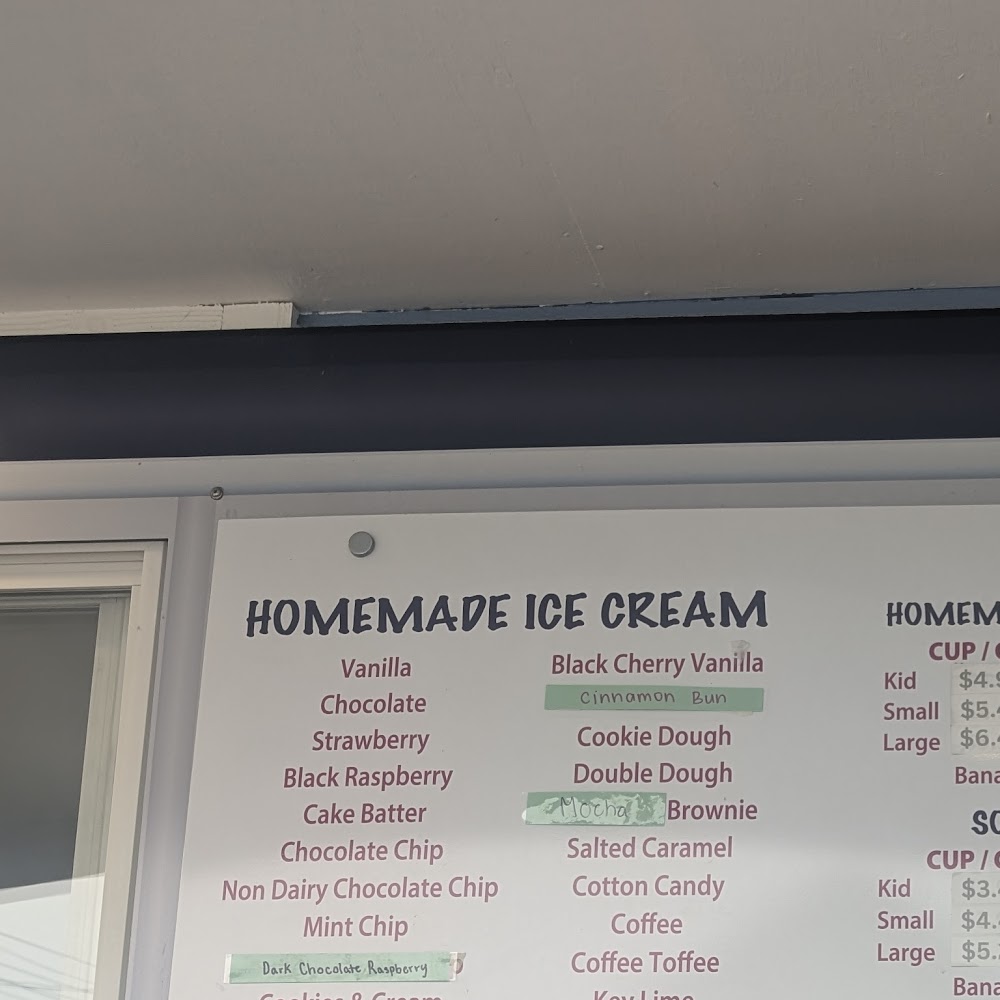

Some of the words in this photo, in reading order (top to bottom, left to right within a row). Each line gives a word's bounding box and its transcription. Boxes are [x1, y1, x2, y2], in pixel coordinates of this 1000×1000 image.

[246, 594, 510, 637] HOMEMADE
[525, 593, 587, 629] ICE
[601, 590, 768, 629] CREAM
[929, 642, 975, 660] CUP
[342, 657, 411, 678] Vanilla
[552, 653, 608, 674] Black
[614, 653, 685, 678] Cherry
[691, 652, 763, 672] Vanilla
[885, 672, 916, 689] Kid
[692, 691, 726, 704] Bun
[884, 702, 938, 720] Small
[312, 729, 429, 754] Strawberry
[578, 725, 651, 746] Cookie
[659, 725, 731, 751] Dough
[884, 734, 940, 755] Large
[284, 766, 339, 788] Black
[345, 765, 453, 791] Raspberry
[668, 799, 757, 820] Brownie
[281, 840, 387, 862] Chocolate
[394, 839, 443, 865] Chip
[879, 879, 910, 897] Kid
[612, 912, 682, 934] Coffee
[878, 910, 933, 929] Small
[878, 943, 935, 966] Large
[263, 961, 291, 975] Dark
[299, 962, 361, 975] Chocolate
[368, 960, 427, 978] Raspberry
